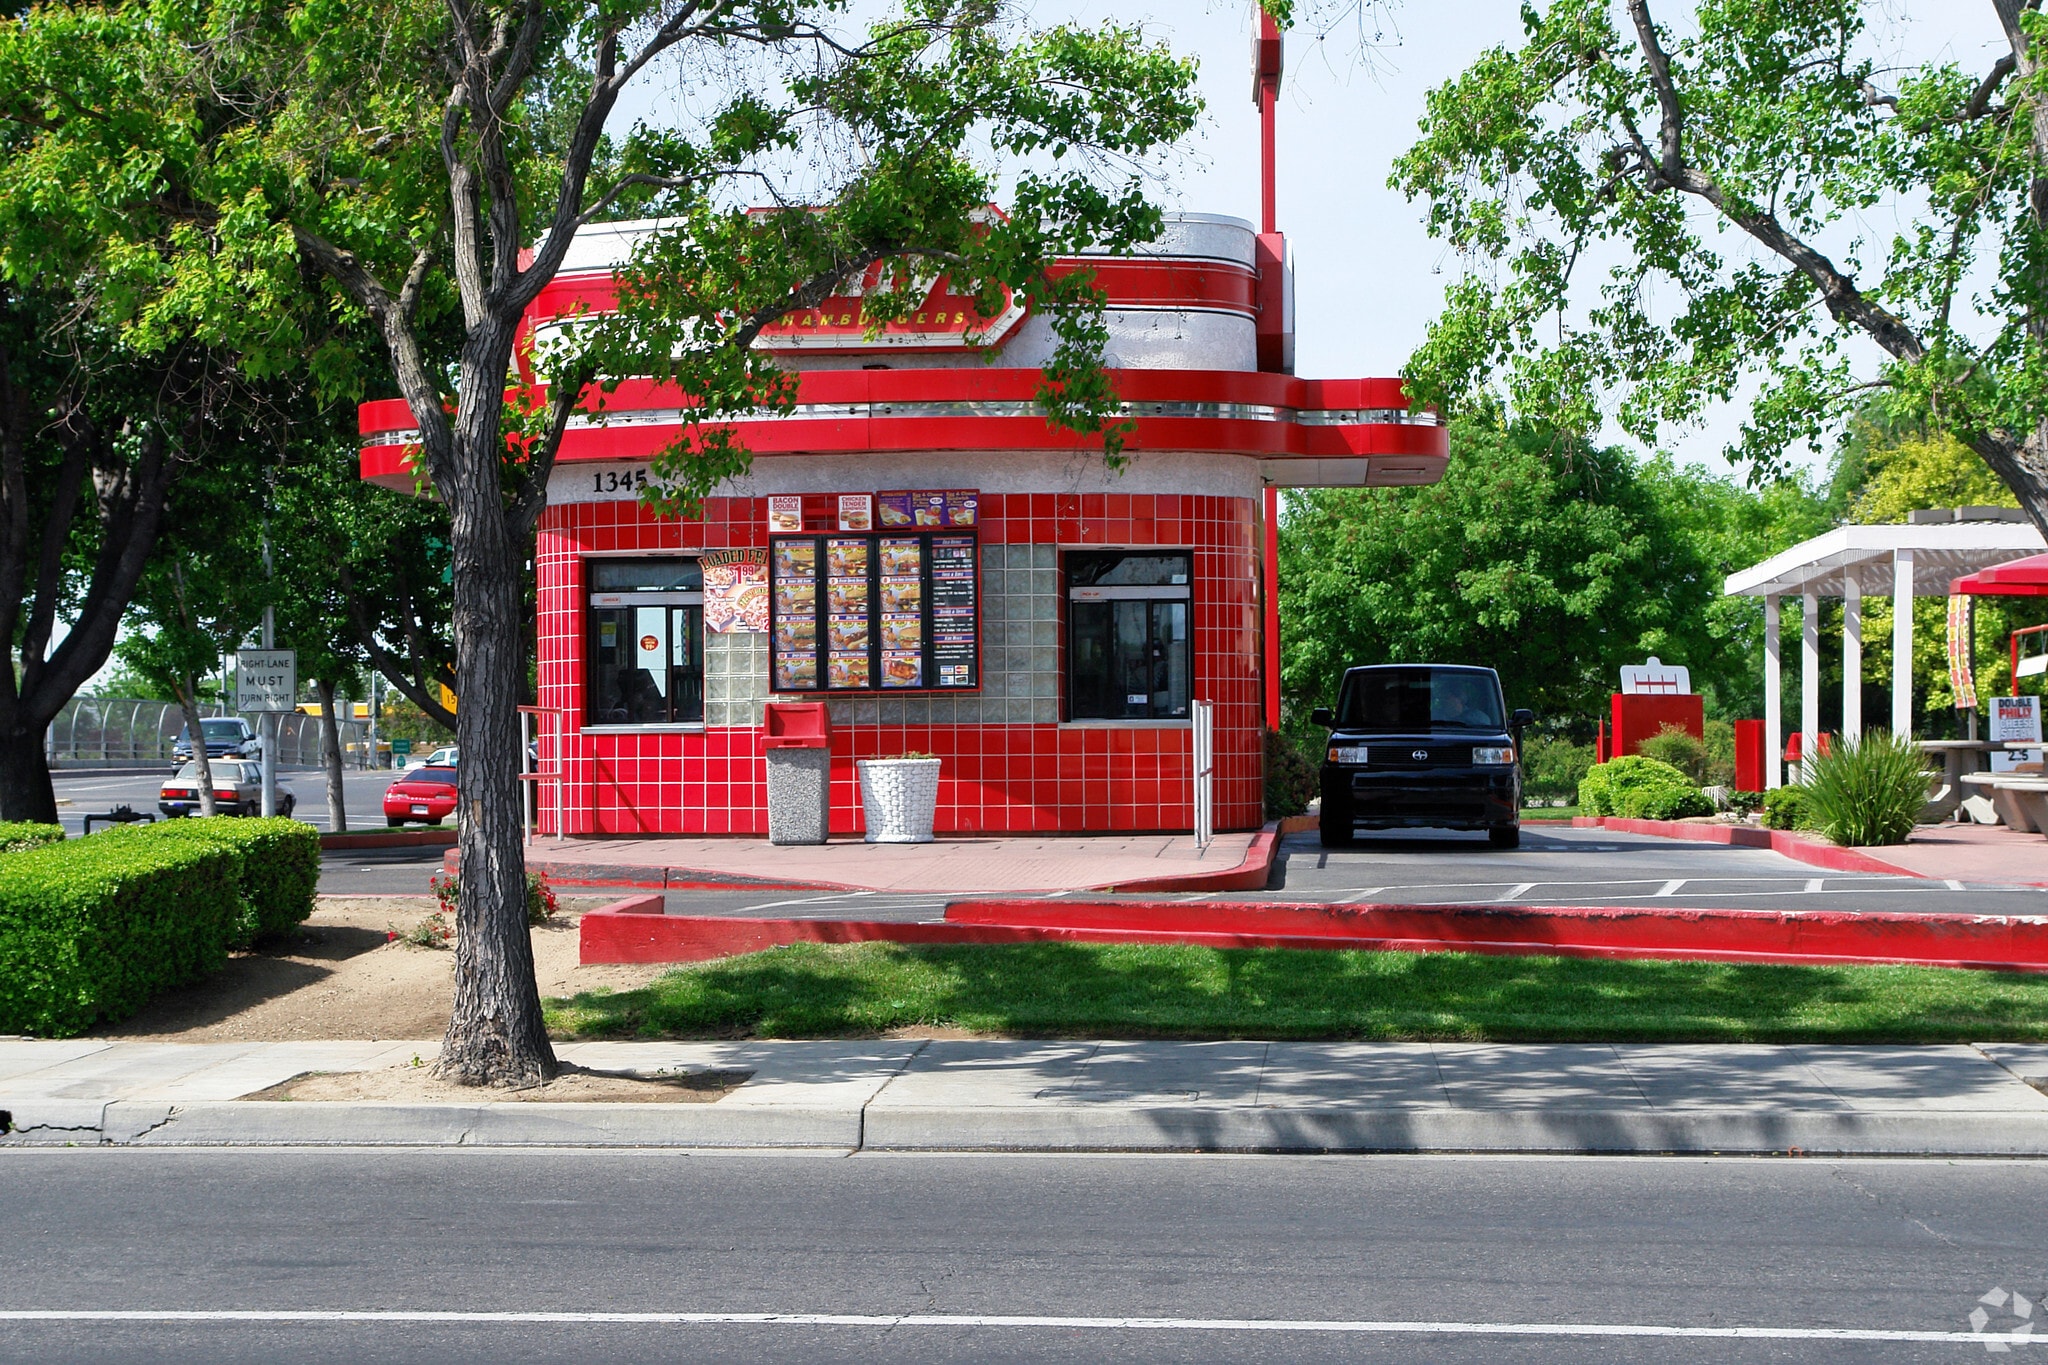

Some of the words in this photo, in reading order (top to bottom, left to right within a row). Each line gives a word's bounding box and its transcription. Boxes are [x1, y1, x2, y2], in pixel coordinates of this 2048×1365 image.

[781, 311, 965, 327] HAMBUGERS
[700, 549, 744, 570] LOADED
[240, 659, 265, 668] RIGHT
[267, 659, 290, 668] LANE
[246, 676, 284, 686] MUST
[240, 694, 262, 702] TURN
[264, 694, 290, 702] RIGHT
[1998, 699, 2032, 708] DOUBLE
[1998, 708, 2032, 719] PHILLY
[2000, 719, 2034, 728] CHEESE
